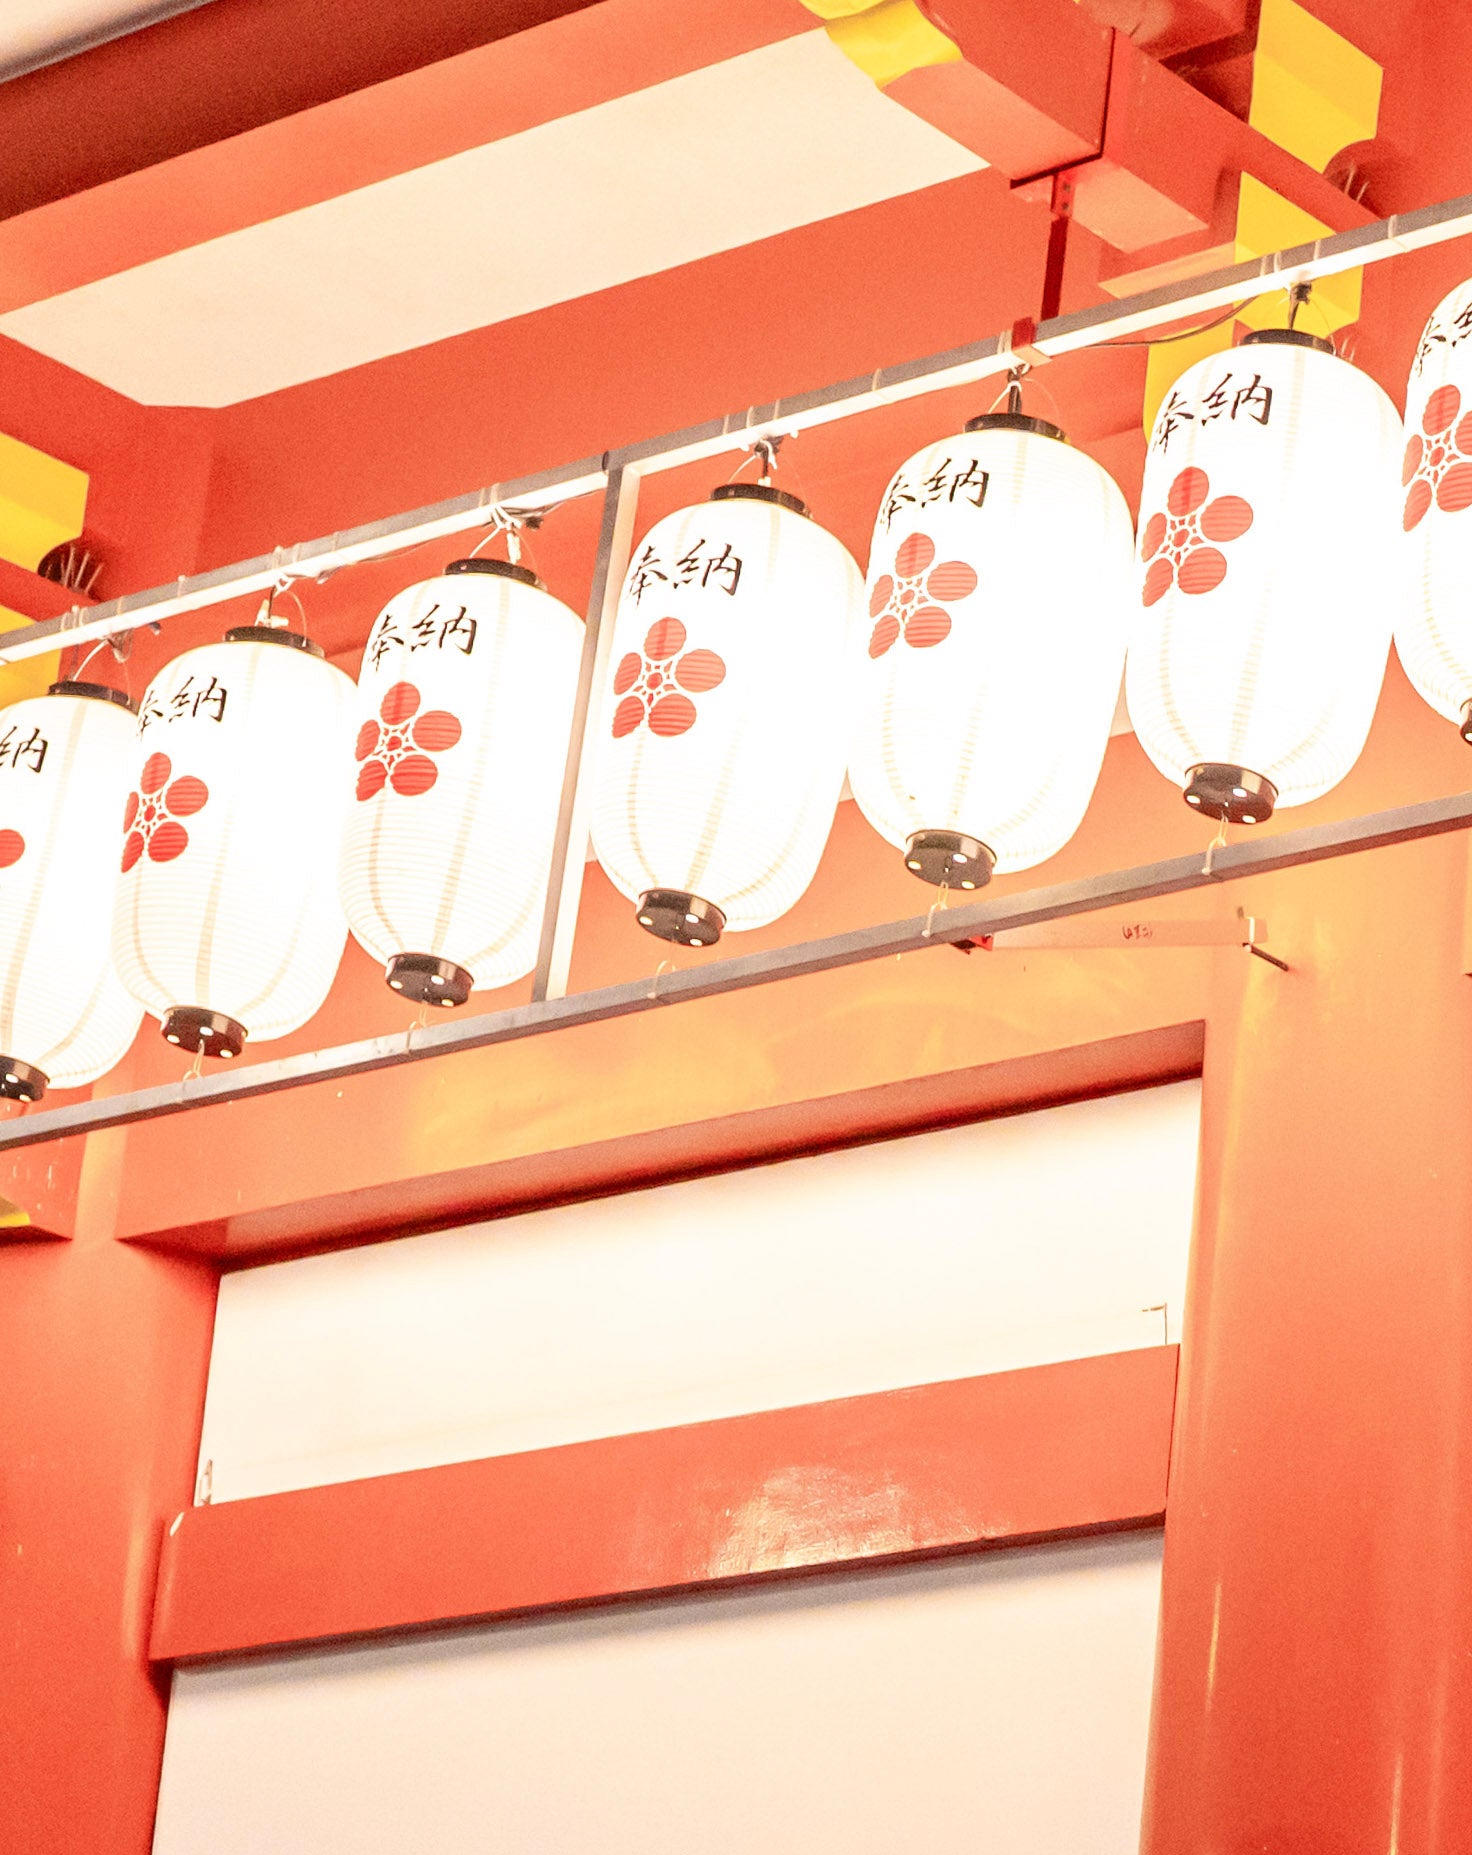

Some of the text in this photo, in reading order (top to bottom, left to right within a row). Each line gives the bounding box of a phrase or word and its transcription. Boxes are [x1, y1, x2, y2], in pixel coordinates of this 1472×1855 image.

[1153, 372, 1274, 455] 奉納
[880, 457, 990, 532] 奉納
[627, 538, 743, 607] 奉納
[364, 604, 479, 673] 奉納
[134, 676, 228, 738] 奉納
